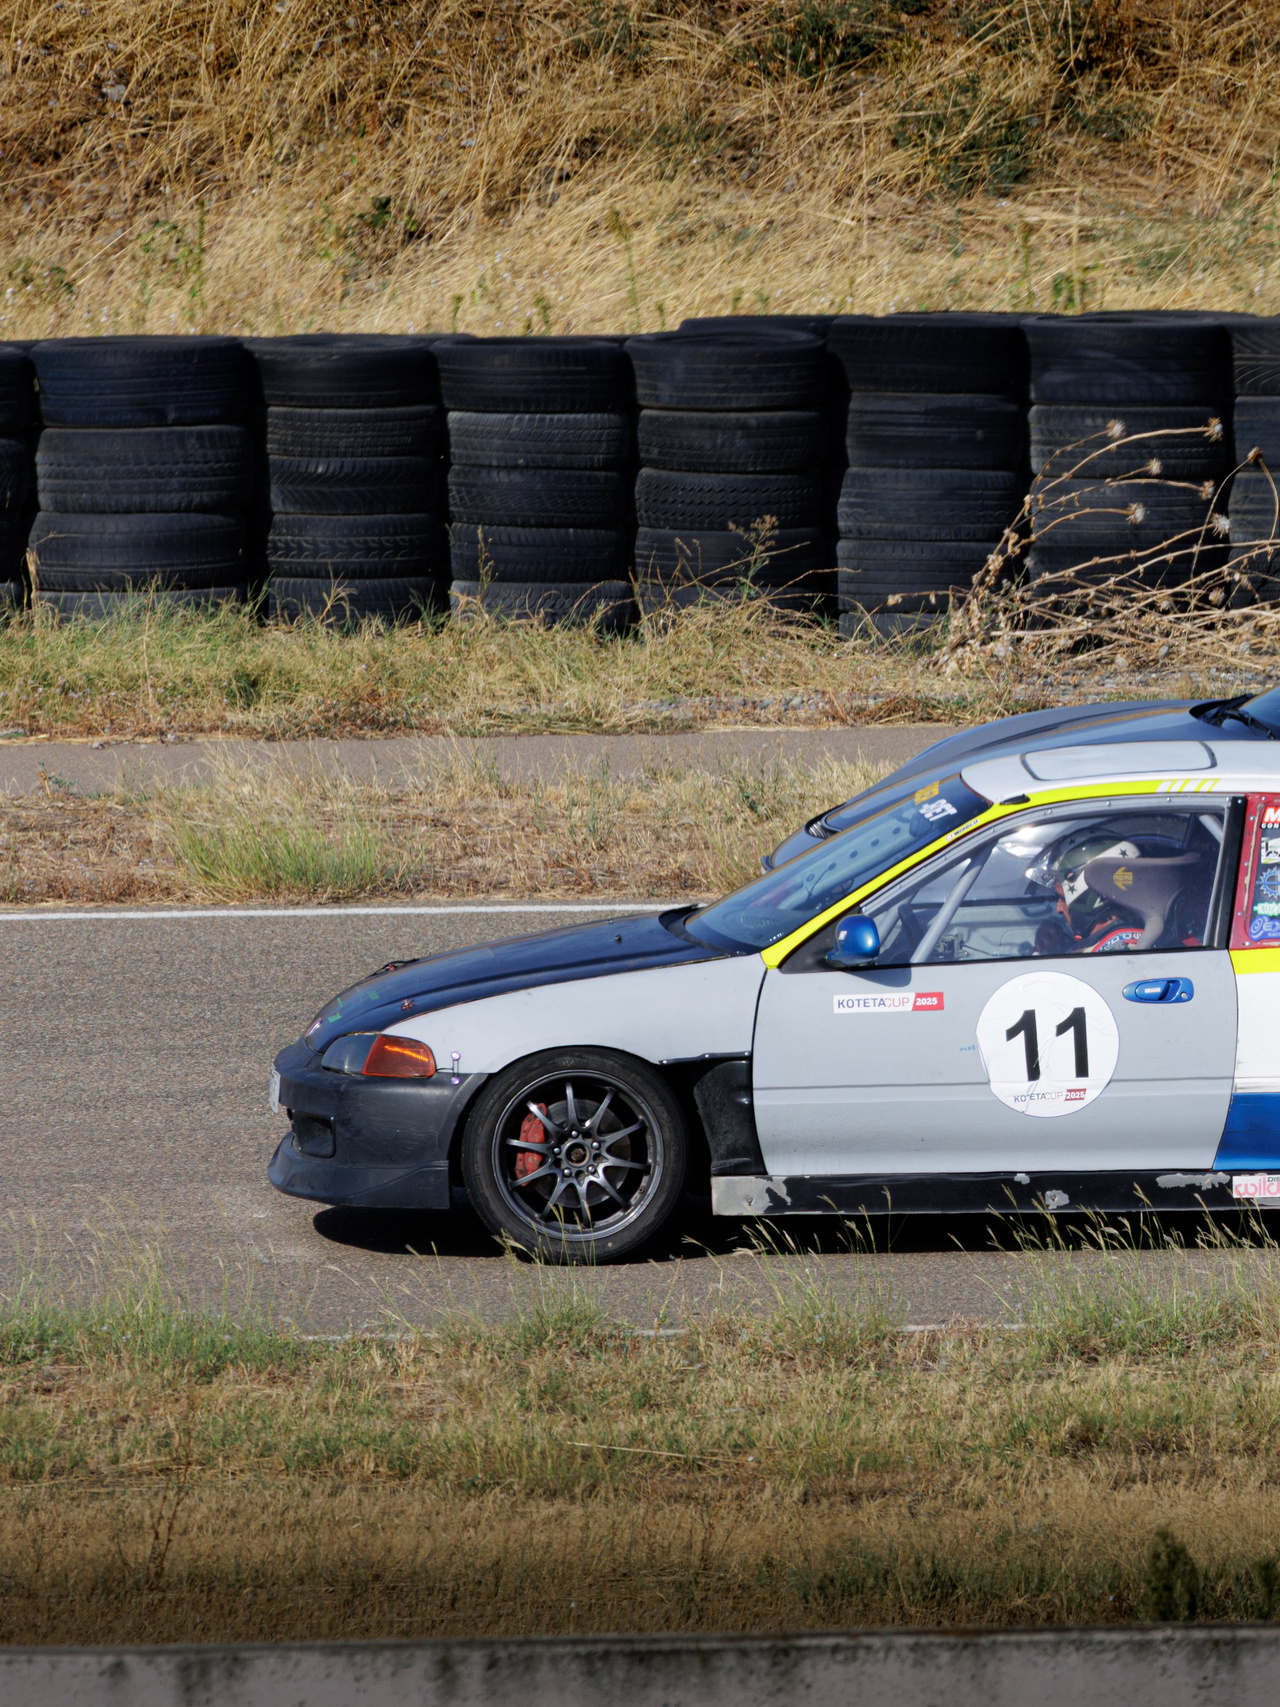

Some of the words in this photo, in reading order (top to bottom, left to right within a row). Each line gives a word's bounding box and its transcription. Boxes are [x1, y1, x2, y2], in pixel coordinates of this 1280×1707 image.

[915, 997, 938, 1006] 2025
[1006, 1006, 1089, 1082] 11
[1066, 1091, 1086, 1100] 2025
